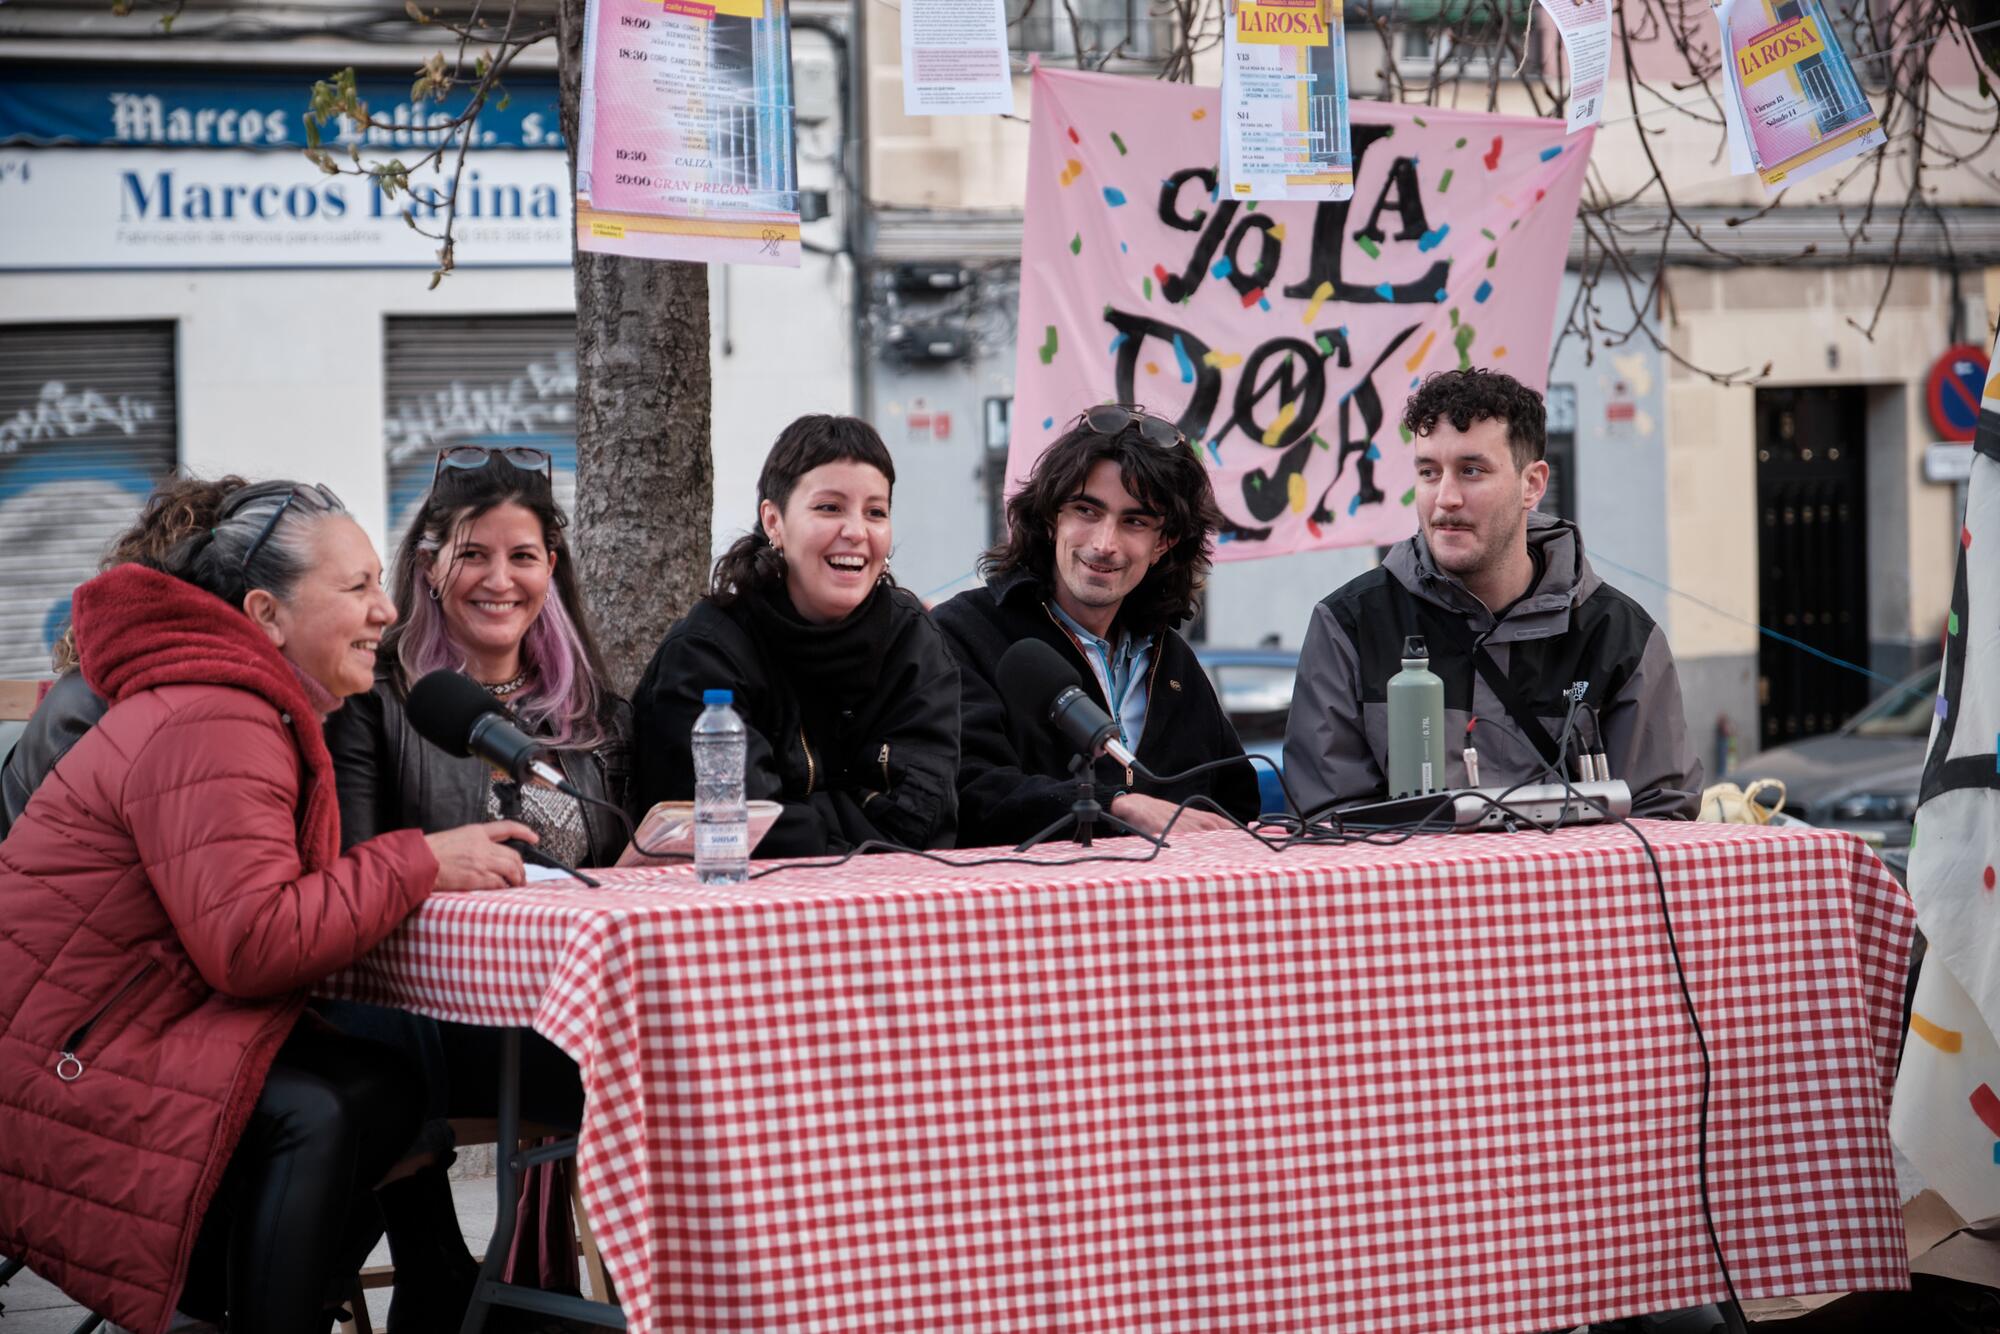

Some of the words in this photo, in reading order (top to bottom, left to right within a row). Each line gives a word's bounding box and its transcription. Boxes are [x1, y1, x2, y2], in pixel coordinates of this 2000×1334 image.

[620, 15, 651, 30] 18:00
[1240, 11, 1263, 33] LA
[1265, 12, 1324, 34] ROSA
[618, 48, 648, 62] 18:30
[1740, 52, 1761, 76] LA
[1760, 26, 1817, 68] ROSA
[108, 92, 288, 144] Marcos
[615, 149, 648, 163] 19:30
[674, 156, 713, 169] CALIZA
[614, 173, 651, 187] 20:00
[653, 177, 690, 191] GRAN
[119, 167, 348, 222] Marcos
